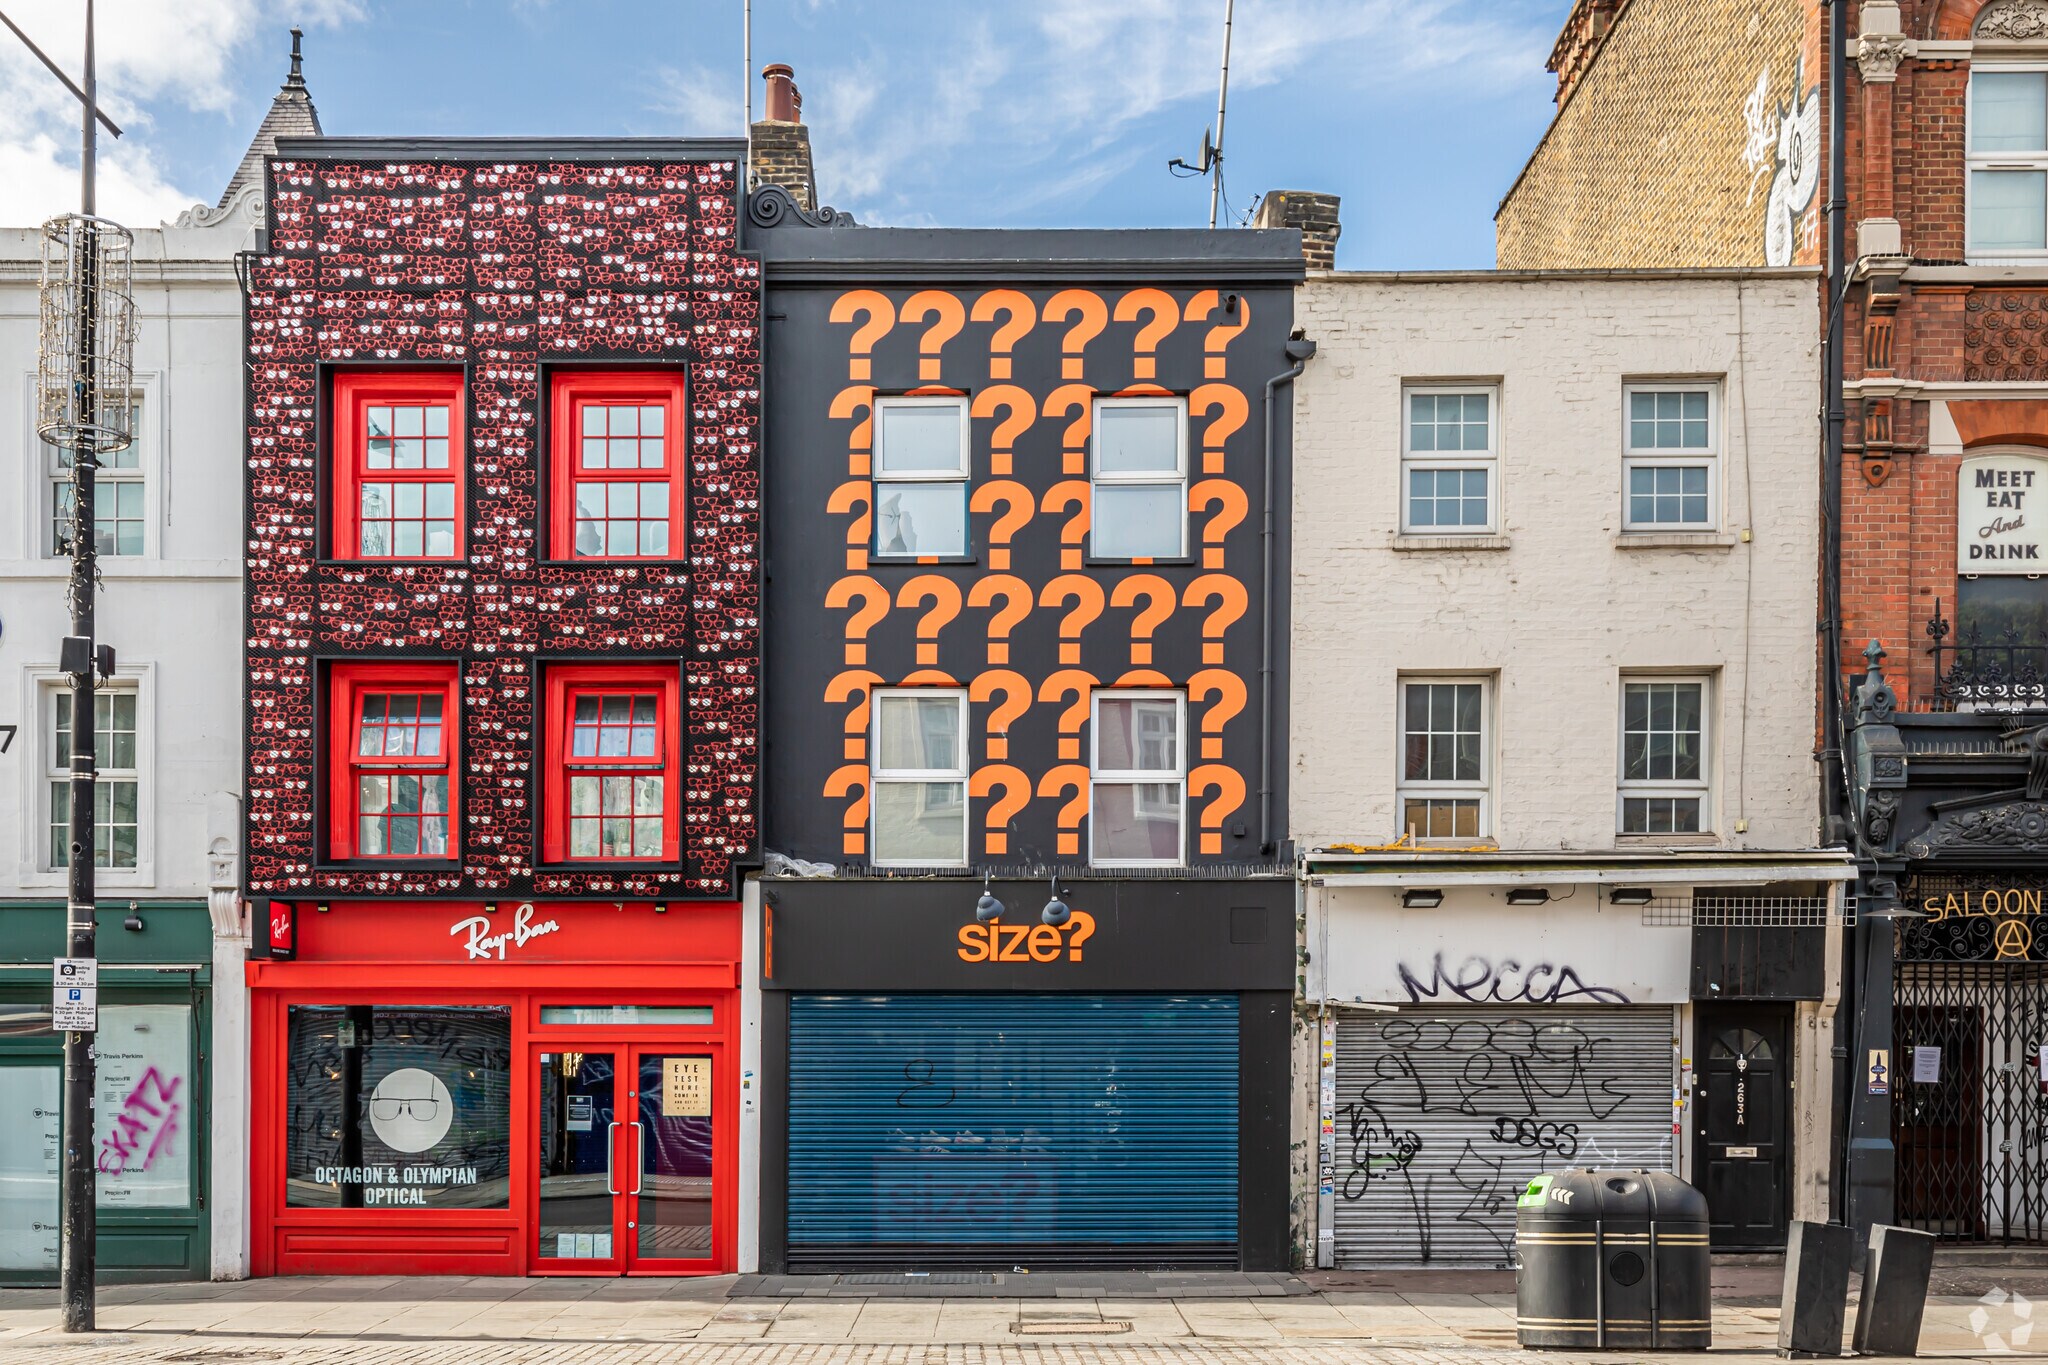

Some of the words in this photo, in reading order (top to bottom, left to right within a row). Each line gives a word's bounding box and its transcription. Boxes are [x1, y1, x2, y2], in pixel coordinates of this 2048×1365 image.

[1975, 469, 2035, 488] MEET
[1987, 491, 2025, 510] EAT
[1978, 514, 2025, 539] And
[1969, 544, 2039, 560] DRINK
[1924, 888, 2041, 923] SALOON
[957, 910, 1096, 963] size?
[674, 1064, 698, 1073] EYE
[674, 1075, 698, 1083] TEST
[315, 1167, 382, 1184] OCTAGON
[387, 1167, 399, 1184] &
[403, 1167, 477, 1184] OLYMPIAN
[365, 1187, 427, 1205] OPTICAL
